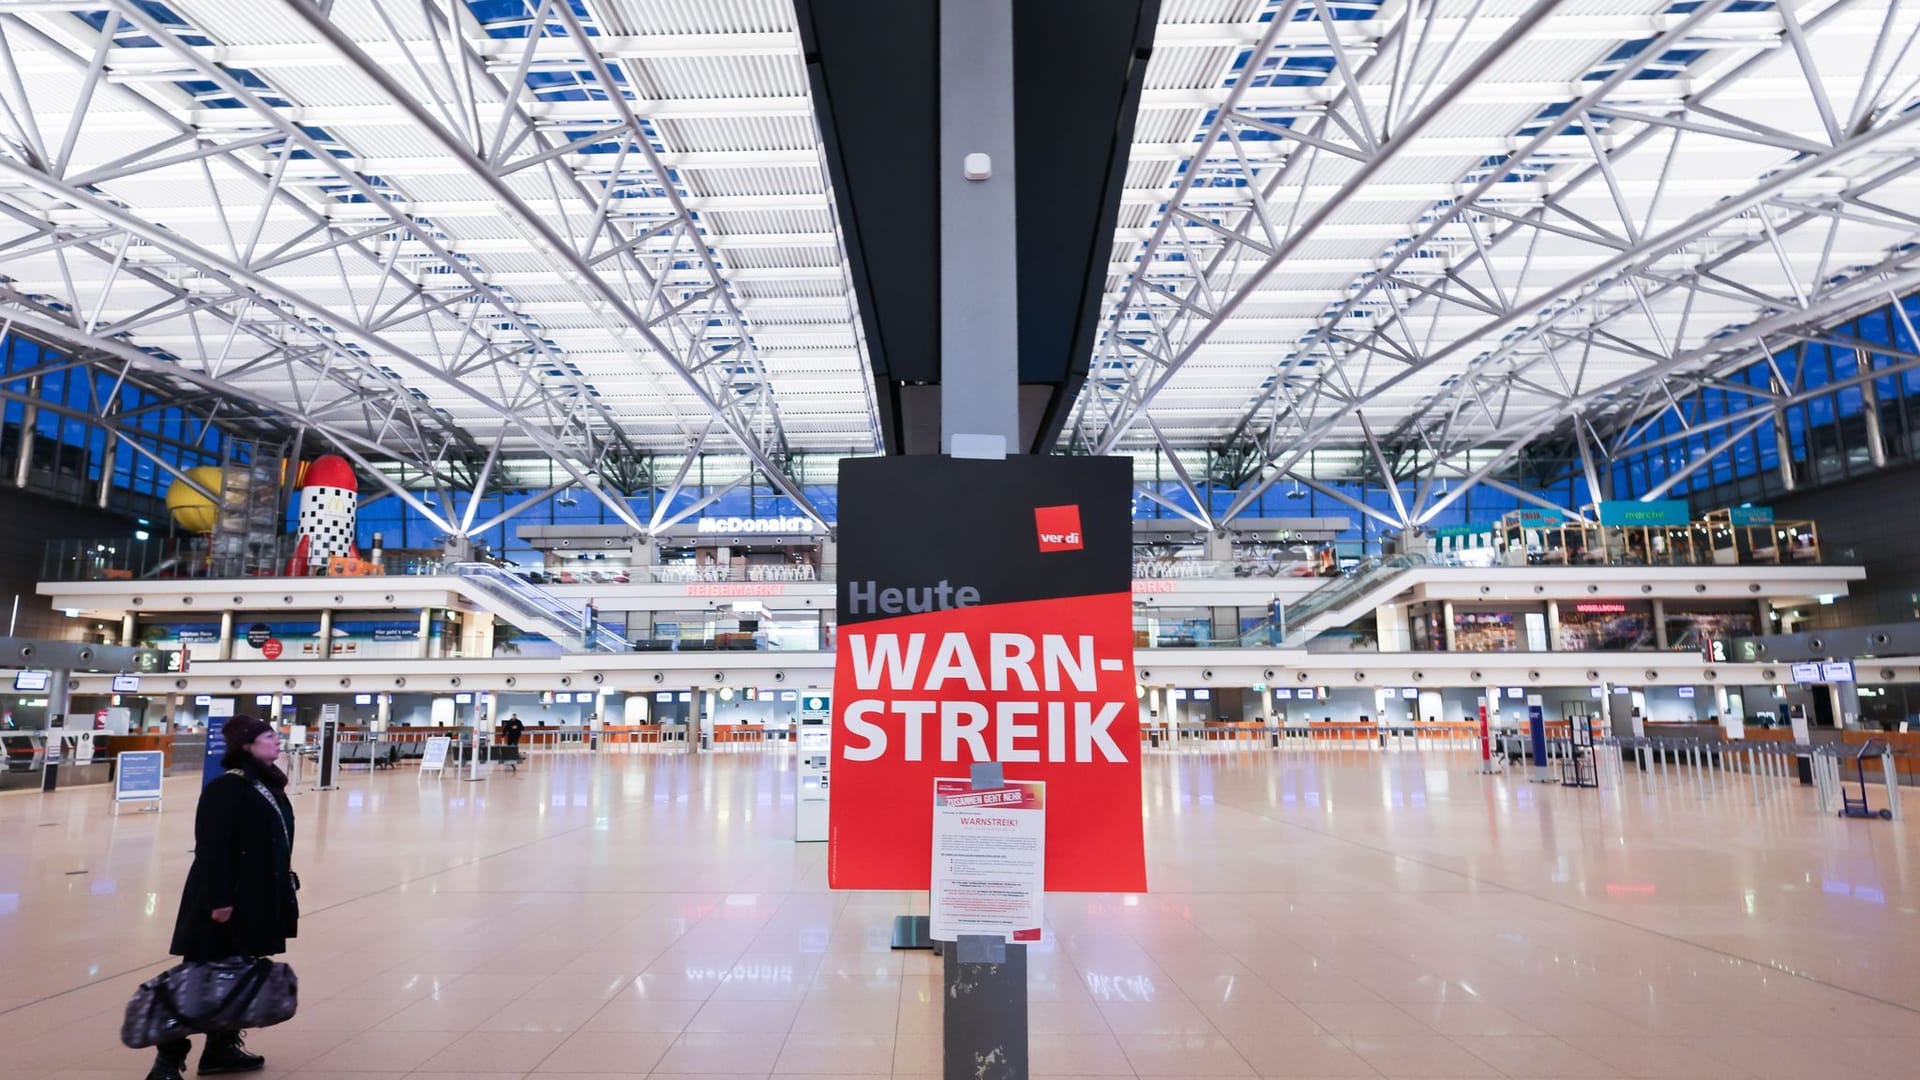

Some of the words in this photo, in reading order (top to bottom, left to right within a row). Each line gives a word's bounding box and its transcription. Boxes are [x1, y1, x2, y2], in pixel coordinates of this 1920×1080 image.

[698, 515, 814, 533] McDonald's
[686, 583, 785, 597] REISEMARKT
[849, 579, 981, 614] Heute
[1713, 641, 1726, 657] 2
[169, 651, 181, 666] 3
[848, 632, 1124, 692] WARN-
[843, 699, 1129, 763] STREIK
[945, 796, 983, 807] ZUSAMMEN
[983, 793, 1002, 804] GEHT
[1003, 791, 1022, 802] MEHR
[960, 817, 1018, 827] WARNSTREIK!
